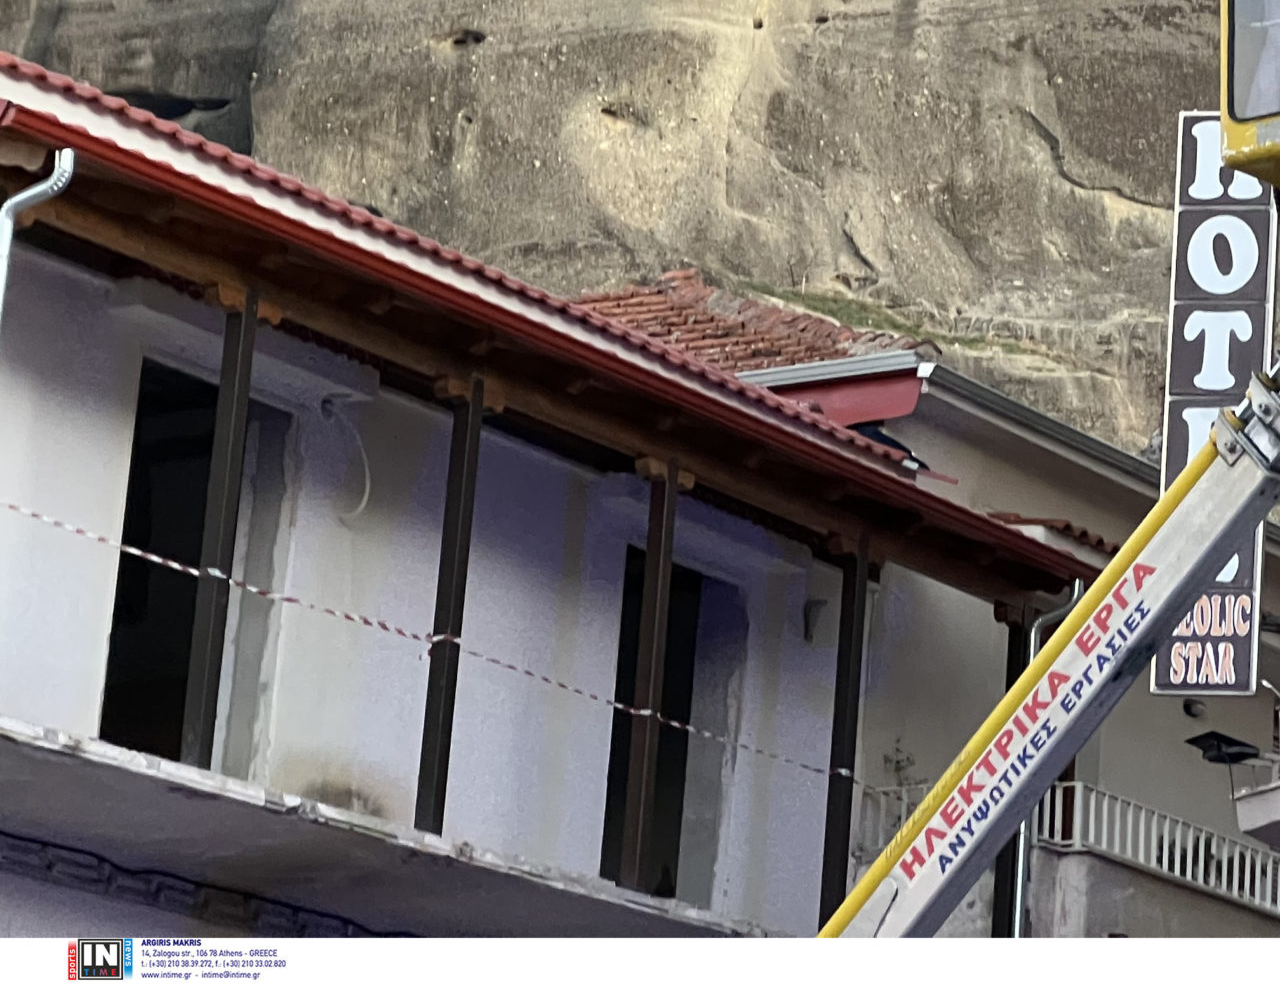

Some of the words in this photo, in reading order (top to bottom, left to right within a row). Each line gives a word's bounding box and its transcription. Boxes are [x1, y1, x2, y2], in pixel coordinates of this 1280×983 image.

[899, 670, 1071, 881] ΗΛΕΚΤΡΙΚΑ
[1075, 562, 1157, 658] ΕΡΓΑ
[939, 718, 1058, 874] ΑΝΥΨΩΤΙΚΕΣ
[1060, 600, 1152, 715] ΕΡΓΑΣΙΕΣ
[1169, 641, 1236, 686] STAR
